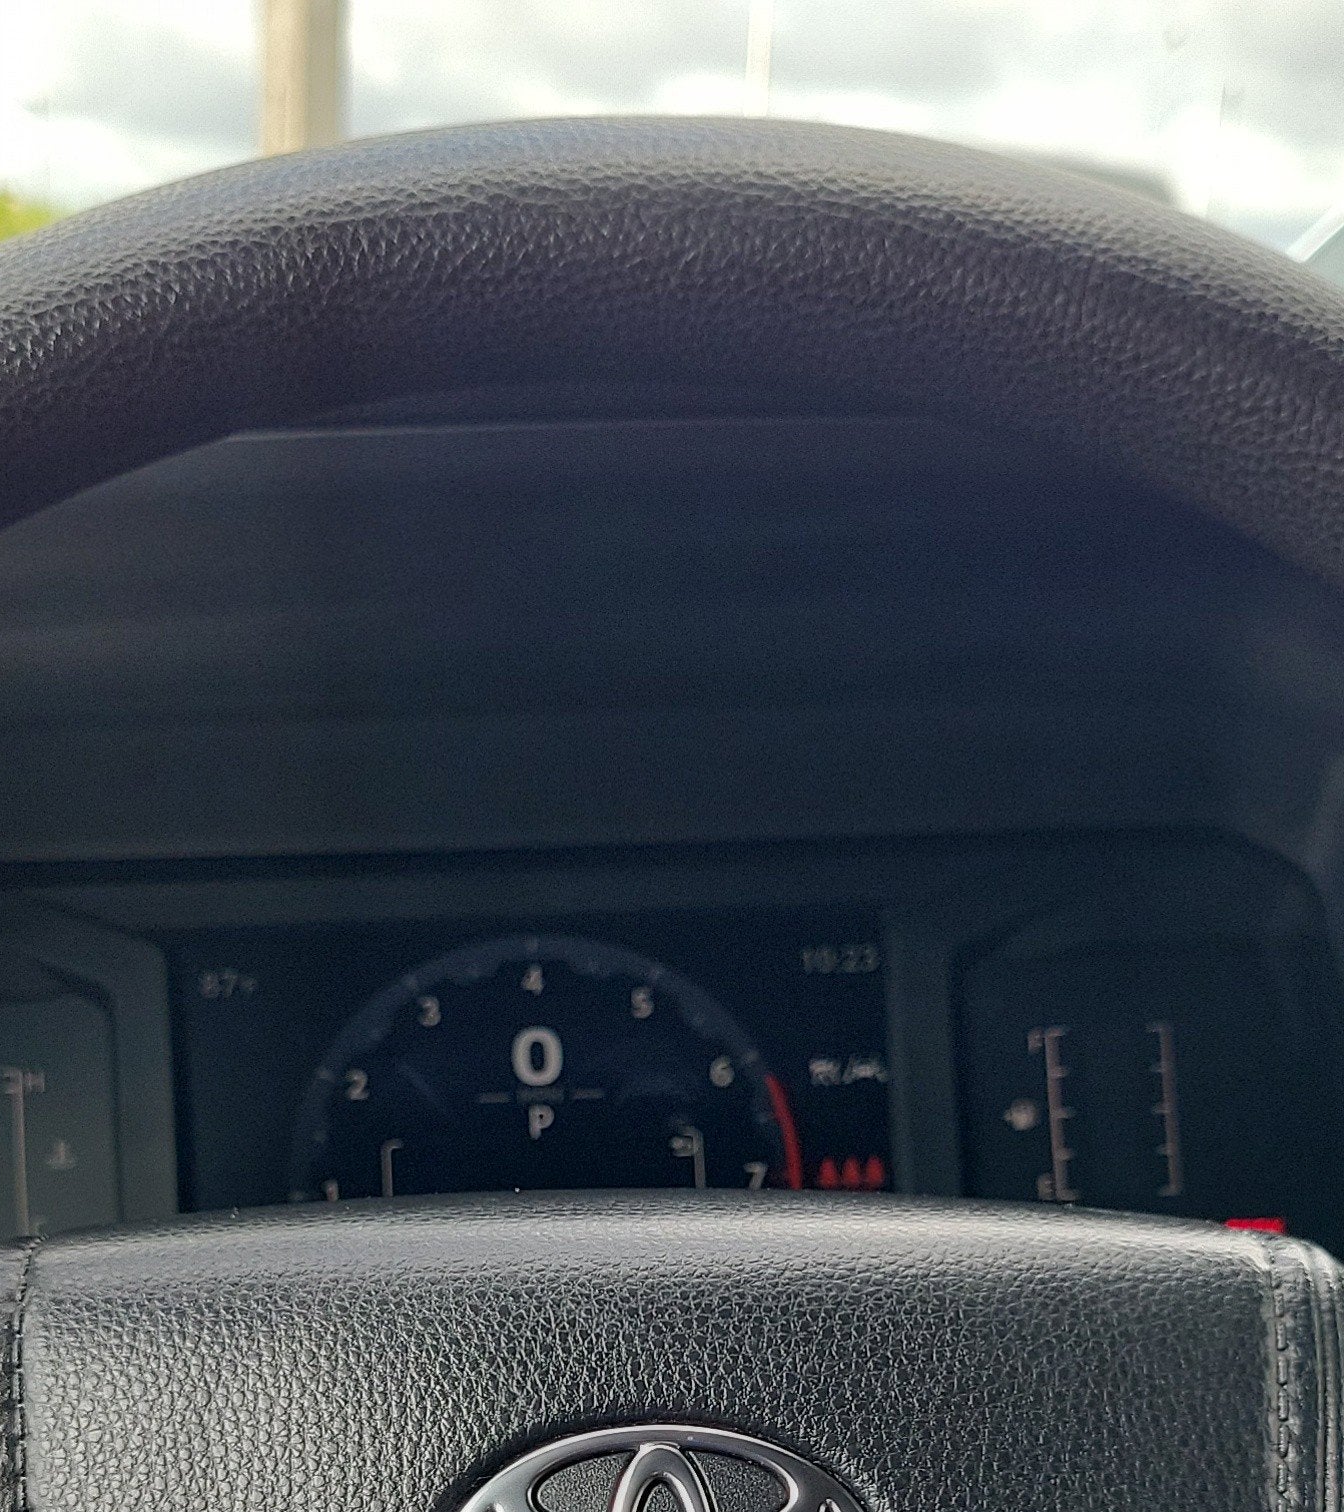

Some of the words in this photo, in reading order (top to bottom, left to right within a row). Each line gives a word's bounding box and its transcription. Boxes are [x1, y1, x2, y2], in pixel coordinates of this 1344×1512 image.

[521, 964, 544, 996] 4
[417, 996, 441, 1027] 3
[630, 987, 655, 1019] 5
[346, 1069, 369, 1100] 2
[709, 1056, 735, 1088] 6
[528, 1105, 555, 1140] P
[743, 1161, 768, 1190] 7
